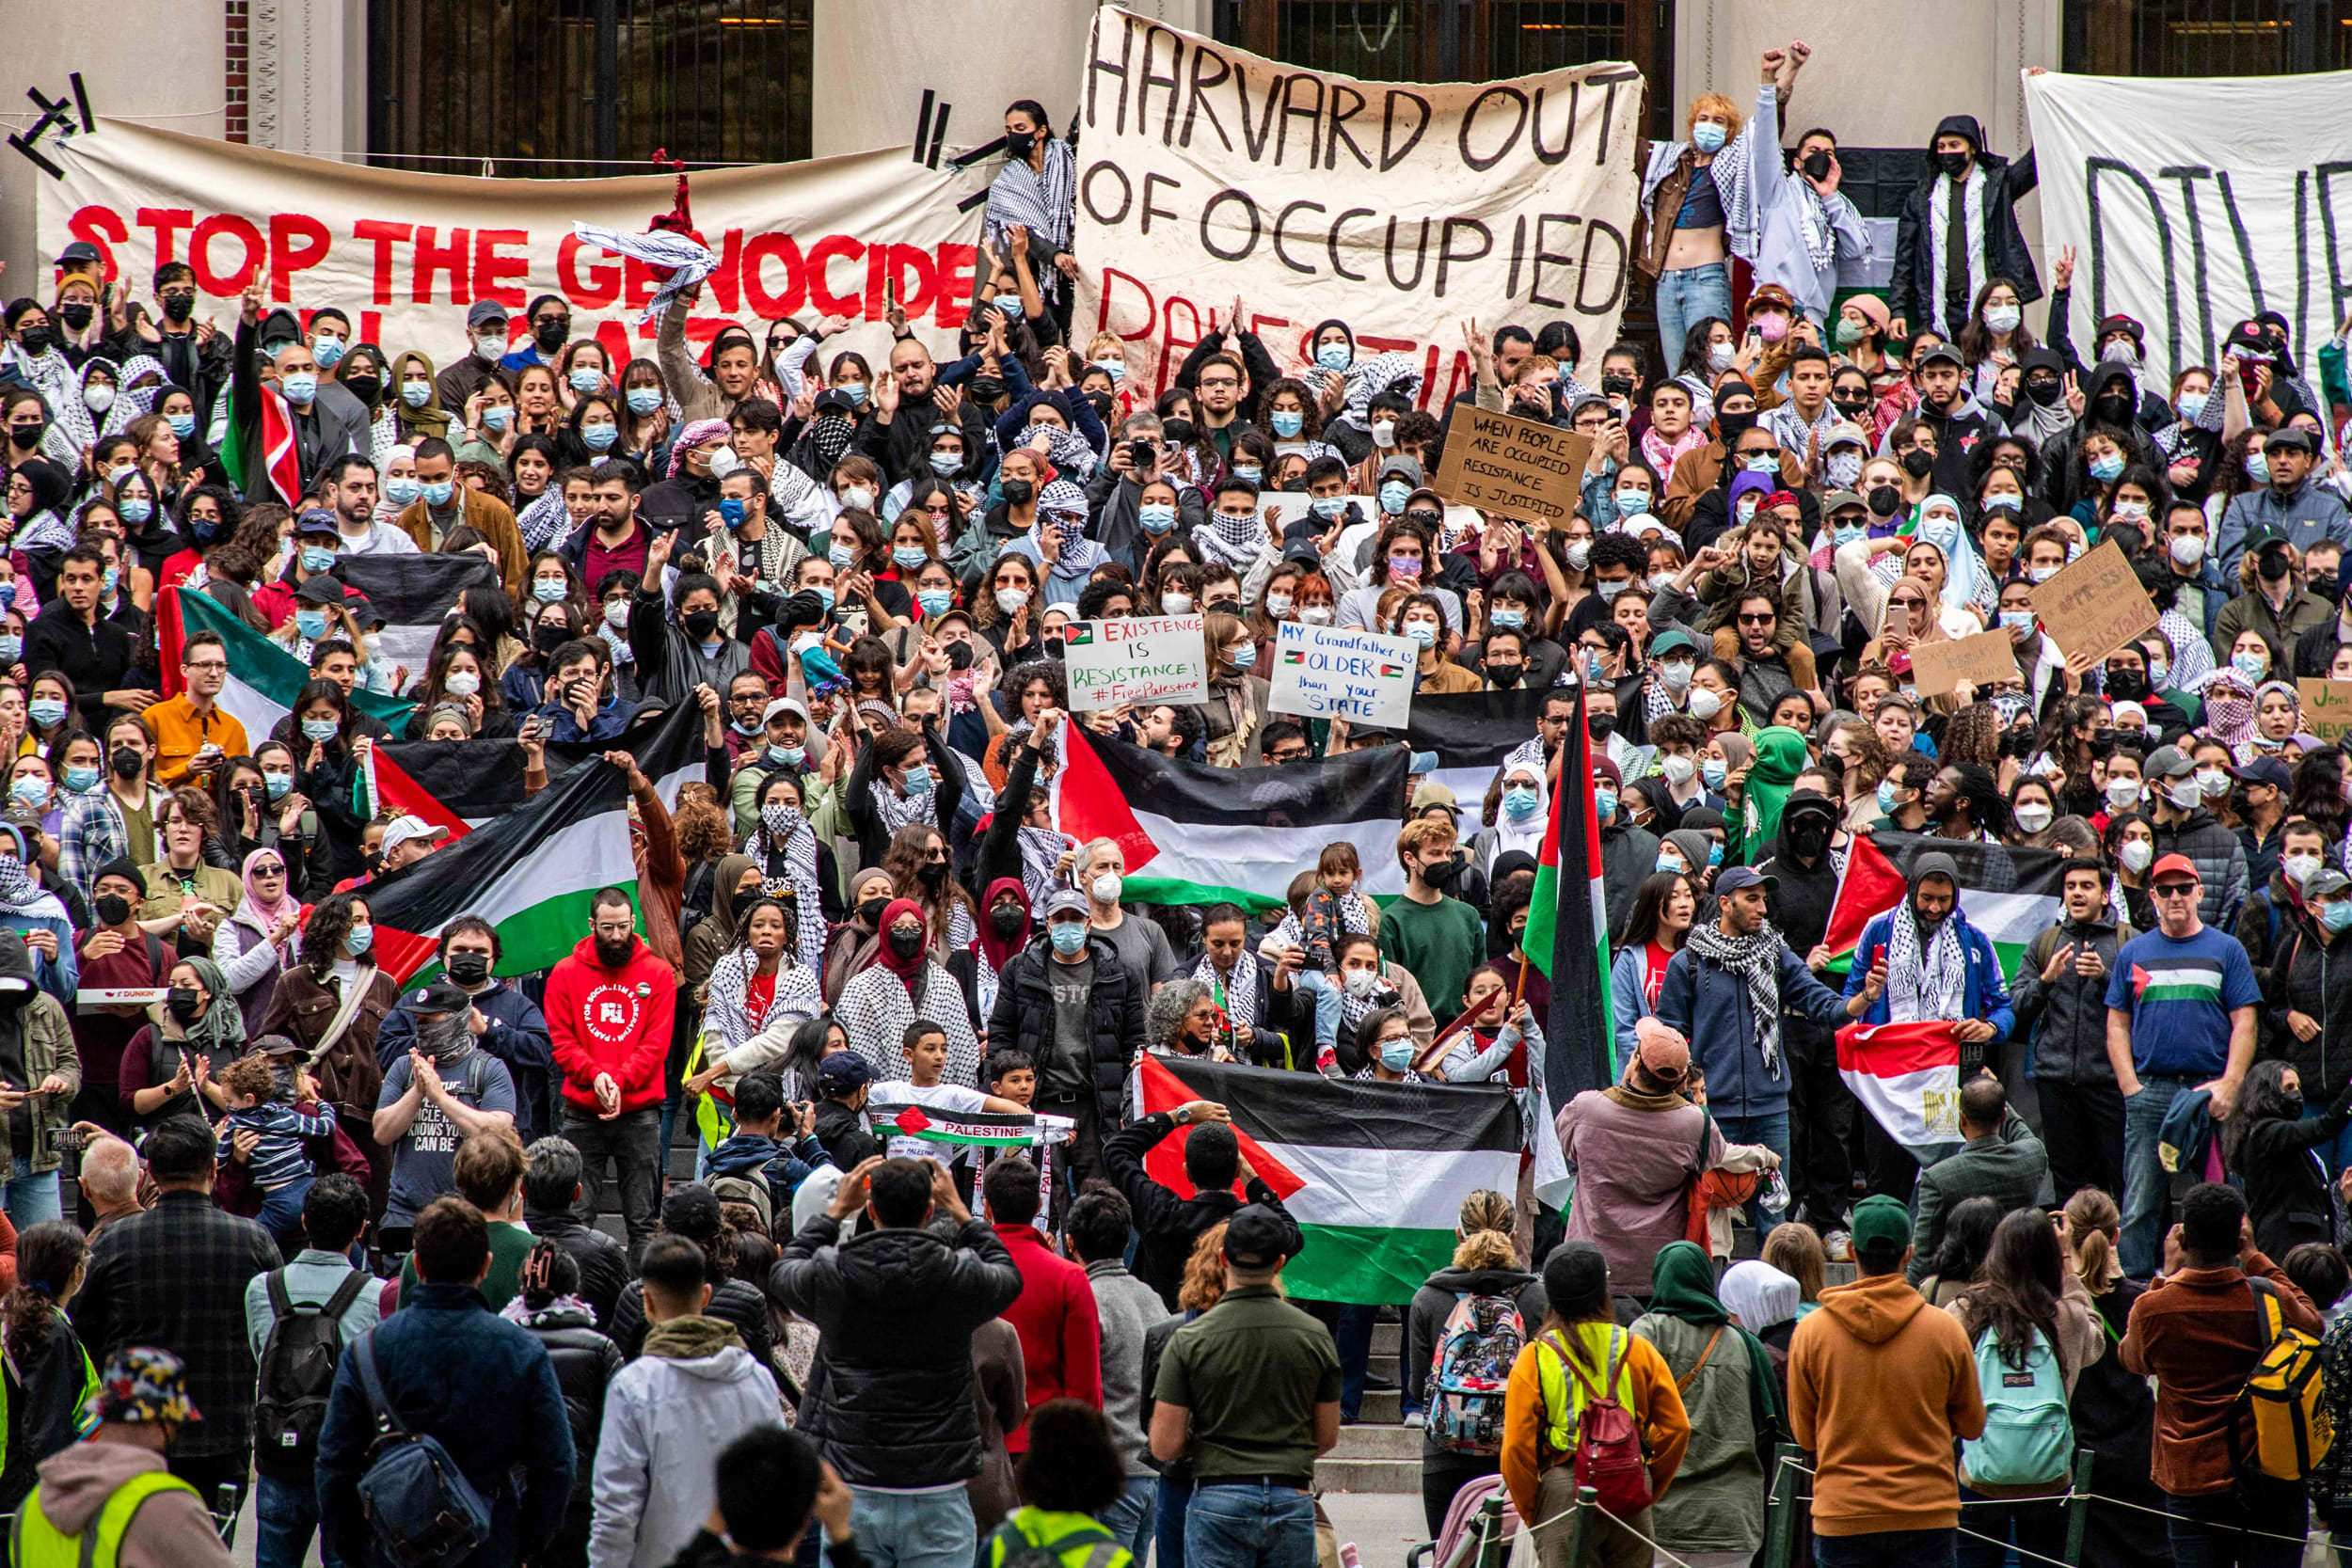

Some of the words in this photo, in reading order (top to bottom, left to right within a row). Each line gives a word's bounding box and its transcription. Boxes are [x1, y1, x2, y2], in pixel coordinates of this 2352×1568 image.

[1087, 18, 1431, 172] HARVARD
[1458, 70, 1641, 172] OUT
[1082, 160, 1180, 235] OF
[1200, 188, 1627, 315] OCCUPIED
[55, 205, 331, 303] STOP
[354, 219, 529, 308] THE
[1473, 417, 1514, 439] WHEN
[1518, 427, 1569, 457] PEOPLE
[1470, 437, 1501, 455] ARE
[1503, 446, 1571, 476] OCCUPIED
[1463, 458, 1544, 491] RESISTANCE
[1462, 482, 1483, 499] IS
[1487, 488, 1565, 518] JUSTIFIED
[1104, 618, 1203, 641] EXISTENCE
[1281, 624, 1305, 641] MY
[1314, 629, 1395, 657] Grandfather
[1128, 641, 1150, 659] IS
[1073, 662, 1199, 689] RESISTANCE!
[1309, 652, 1376, 679] OLDER
[1091, 681, 1199, 704] #FreePalestine
[1298, 675, 1327, 691] than
[1345, 684, 1380, 698] your
[587, 984, 628, 1003] SOCIAIM
[586, 1022, 611, 1042] PARTY
[617, 998, 639, 1042] LIBERATION
[417, 1108, 441, 1122] NCLE
[414, 1136, 437, 1152] CAN
[439, 1137, 455, 1152] BE
[945, 1123, 1023, 1138] PALESTINE
